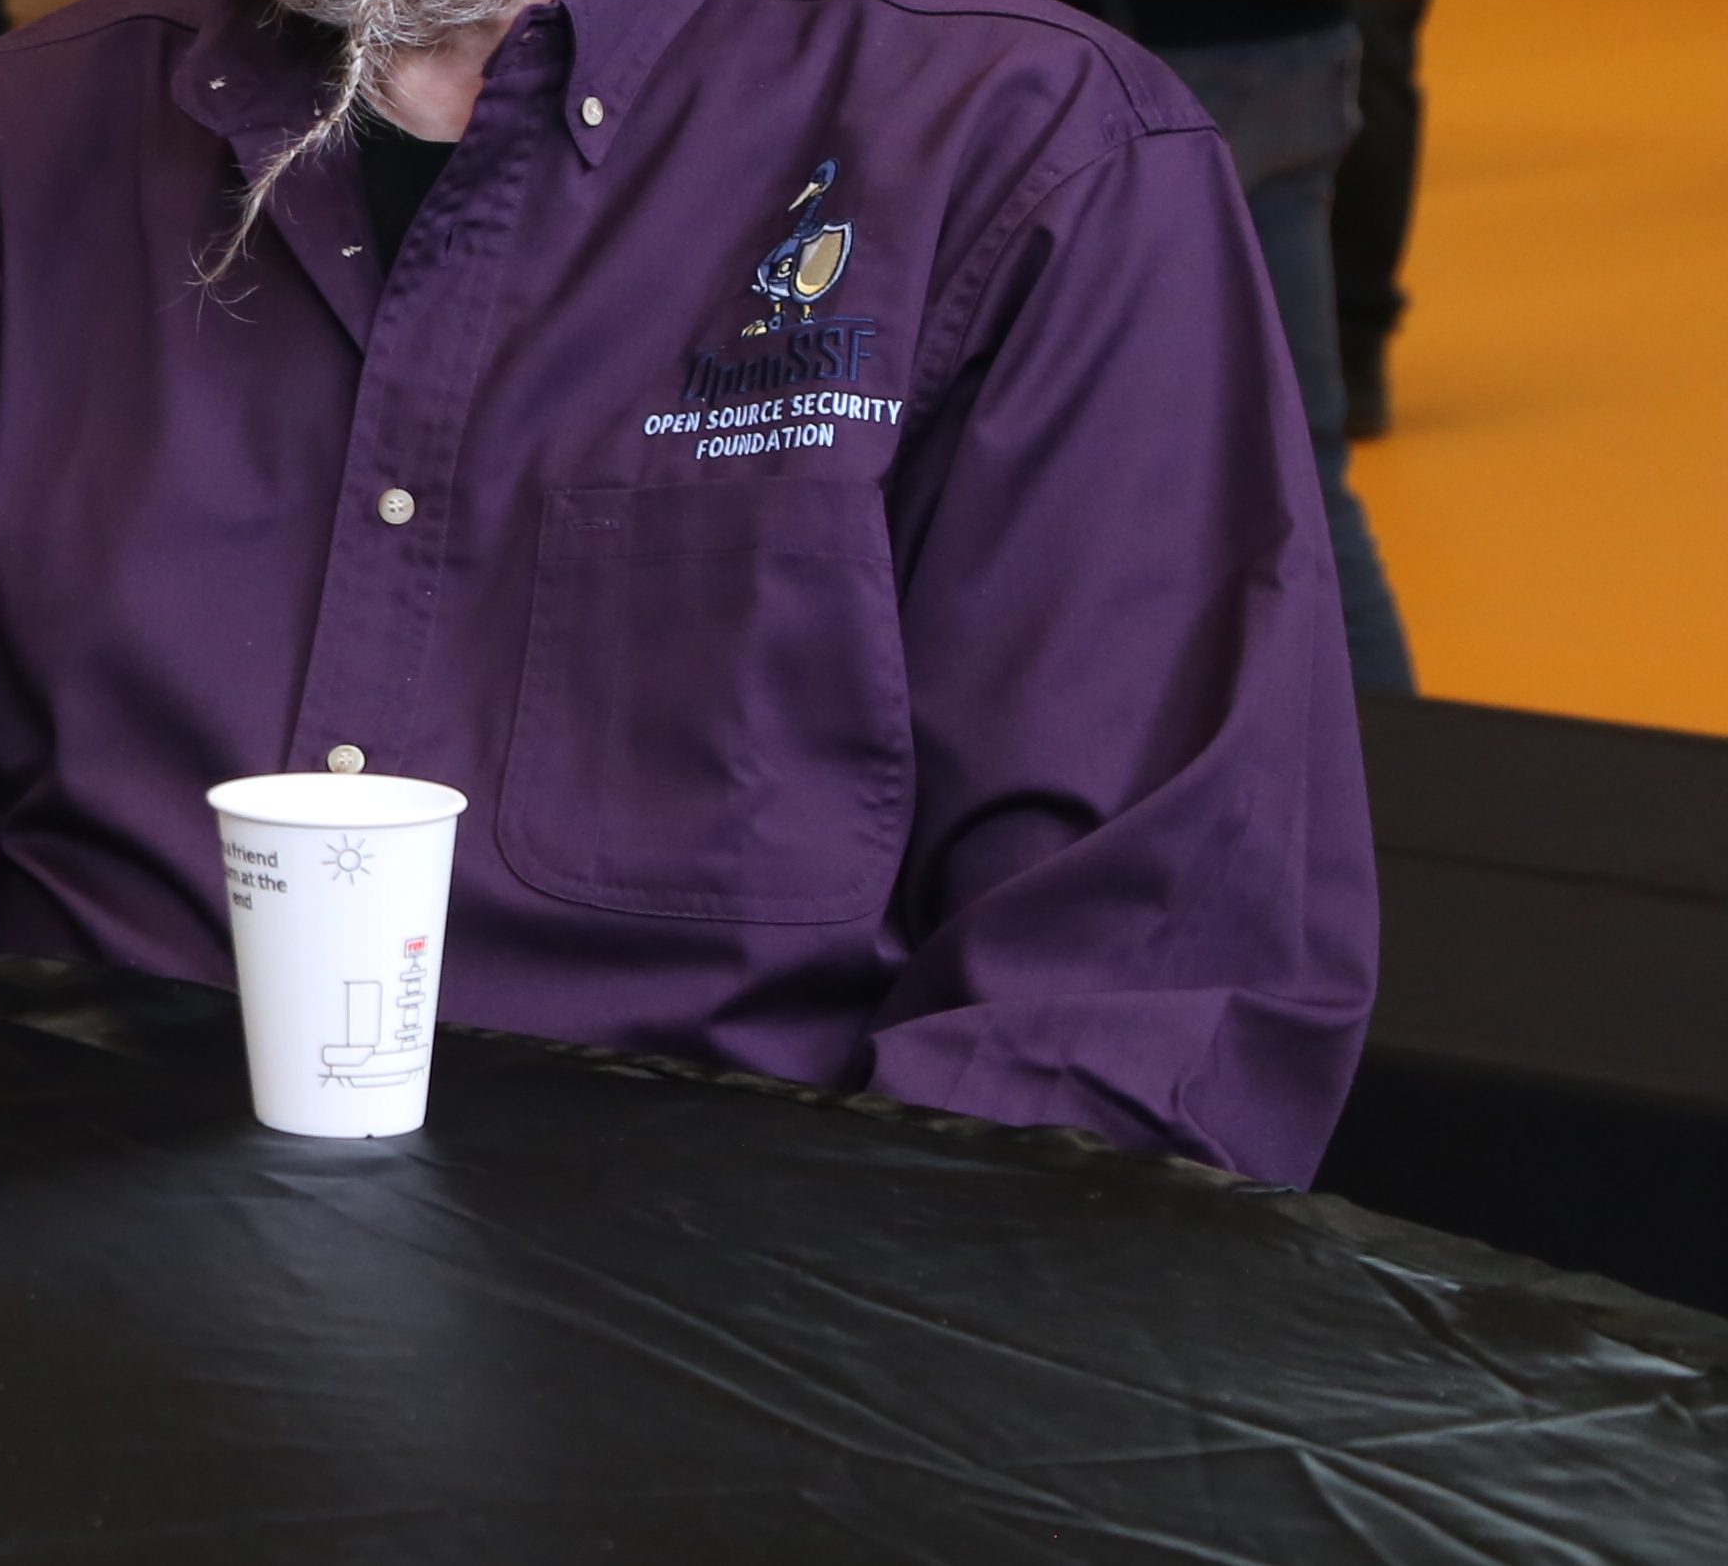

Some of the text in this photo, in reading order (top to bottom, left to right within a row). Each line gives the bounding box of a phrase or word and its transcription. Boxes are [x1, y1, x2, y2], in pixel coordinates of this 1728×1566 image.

[643, 391, 904, 436] OPEN SOURCE SECURITY
[695, 422, 835, 461] FOUNDATION
[231, 841, 279, 869] friend
[241, 872, 255, 888] at
[257, 873, 288, 894] the
[232, 890, 253, 911] end
